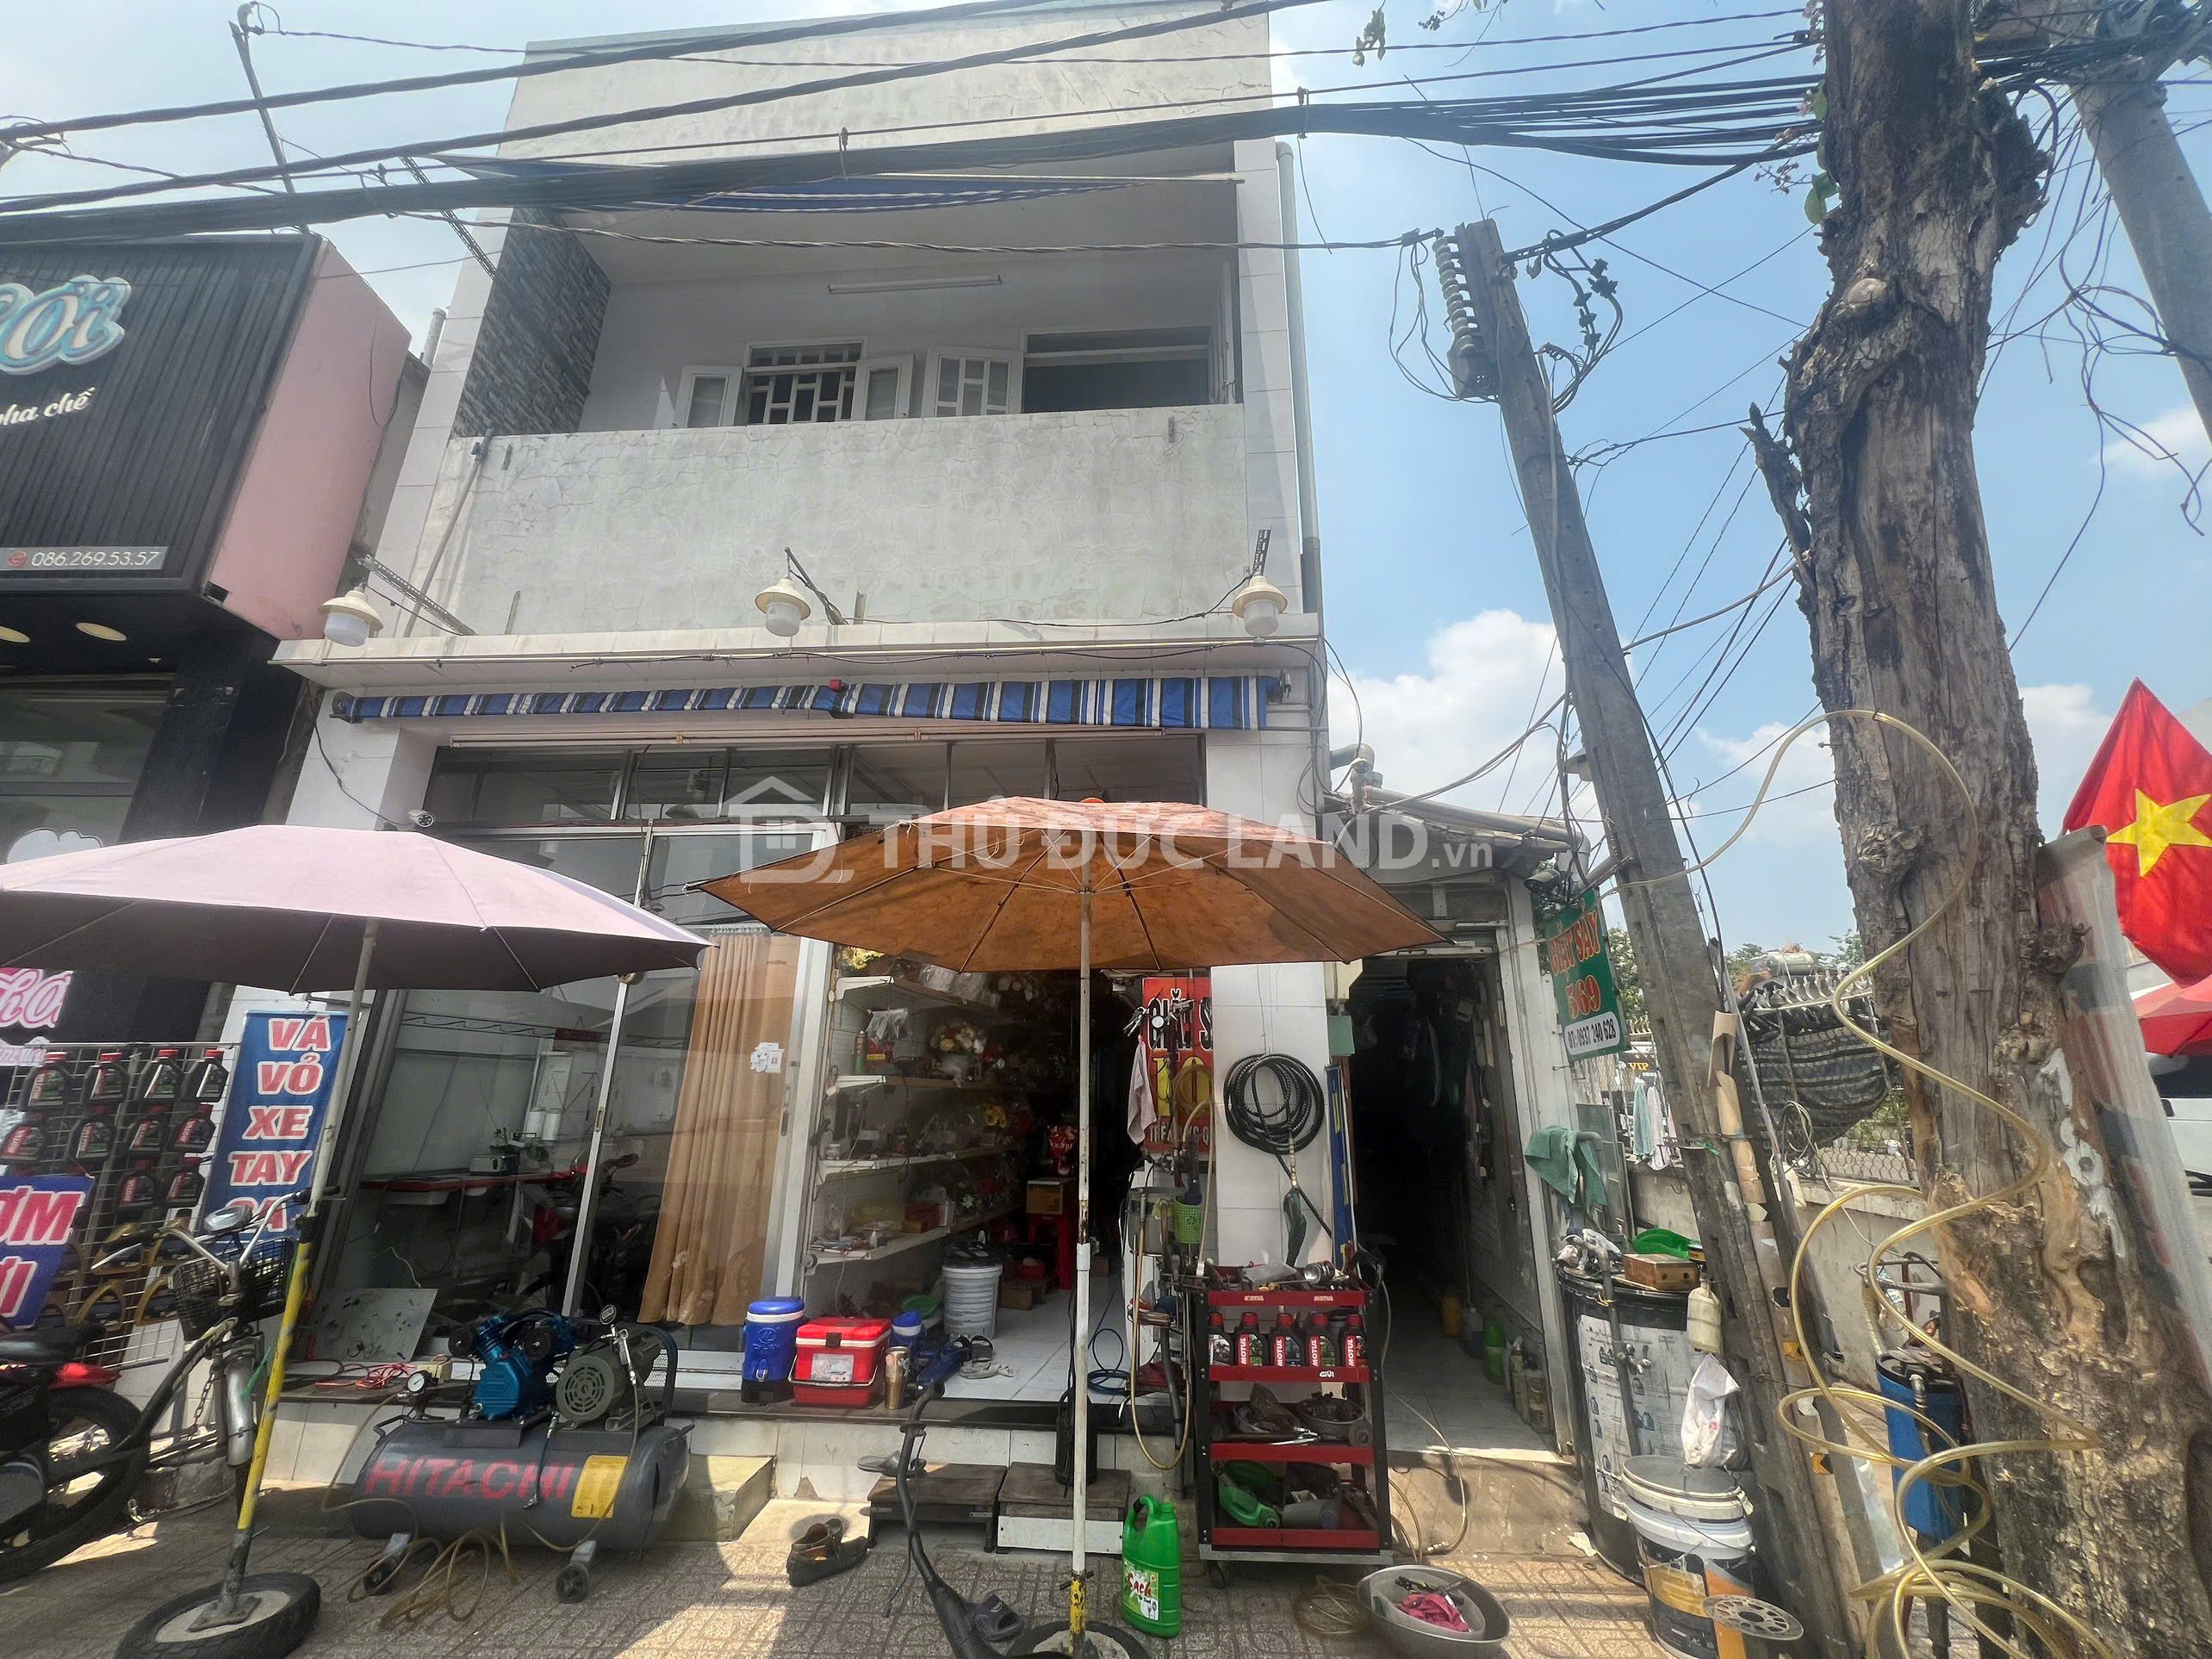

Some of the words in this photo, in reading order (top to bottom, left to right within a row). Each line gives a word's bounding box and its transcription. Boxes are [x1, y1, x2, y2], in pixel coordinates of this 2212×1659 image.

[0, 404, 39, 426] ha
[44, 387, 96, 417] chế
[31, 551, 160, 568] 086.269.53.57
[269, 1014, 331, 1051] VÁ
[1602, 1018, 1616, 1041] 628
[258, 1052, 324, 1095] VỎ
[242, 1105, 313, 1140] XE
[228, 1150, 313, 1186] TAY
[1310, 1339, 1319, 1367] MOTUL
[1346, 1338, 1355, 1367] MOTUL
[364, 1457, 575, 1501] HITACHI
